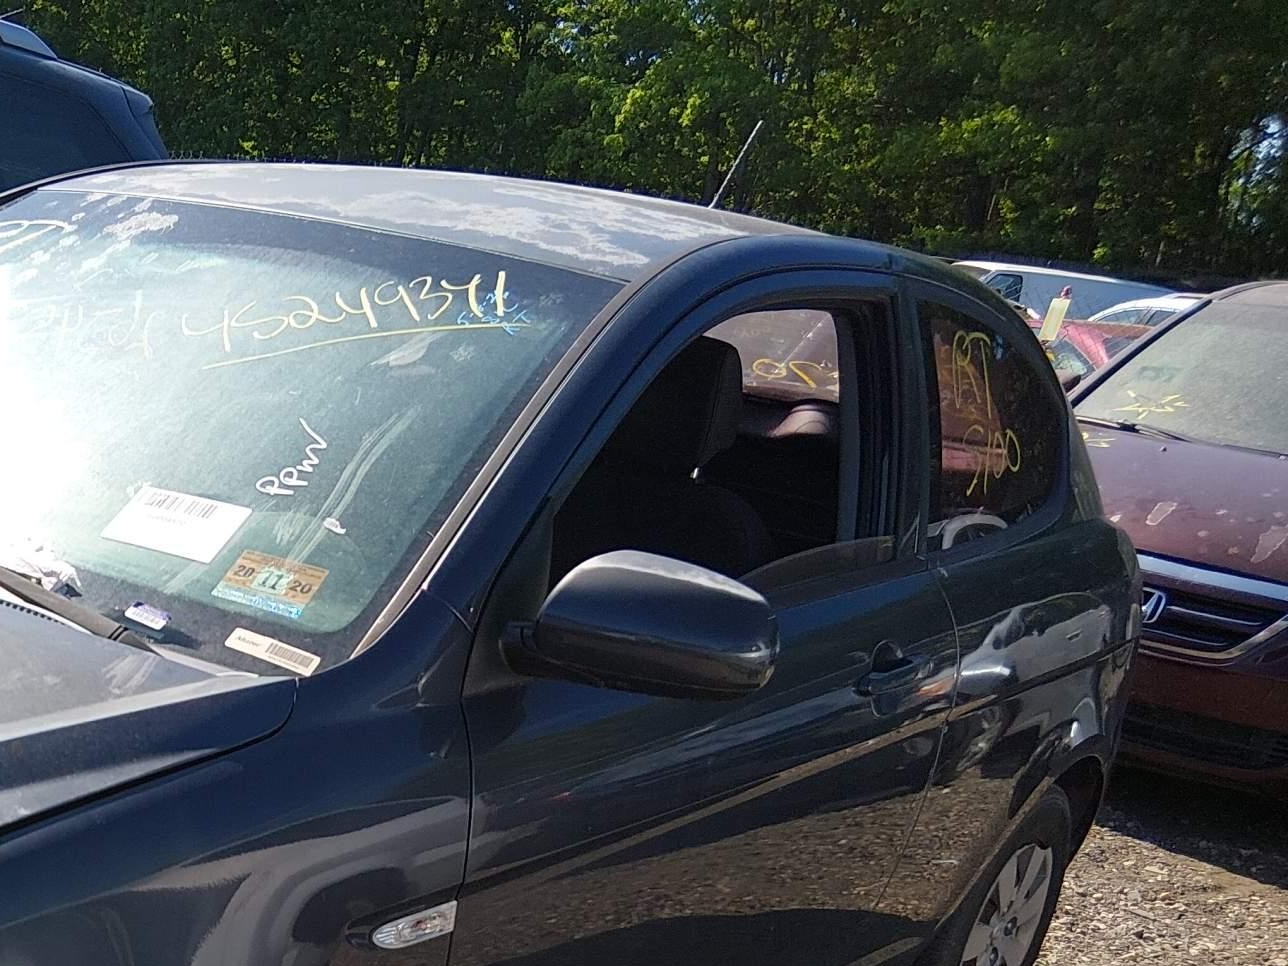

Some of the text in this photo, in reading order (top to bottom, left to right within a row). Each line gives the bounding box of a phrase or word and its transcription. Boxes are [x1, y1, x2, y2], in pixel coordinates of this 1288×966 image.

[233, 563, 313, 595] 20 11 20
